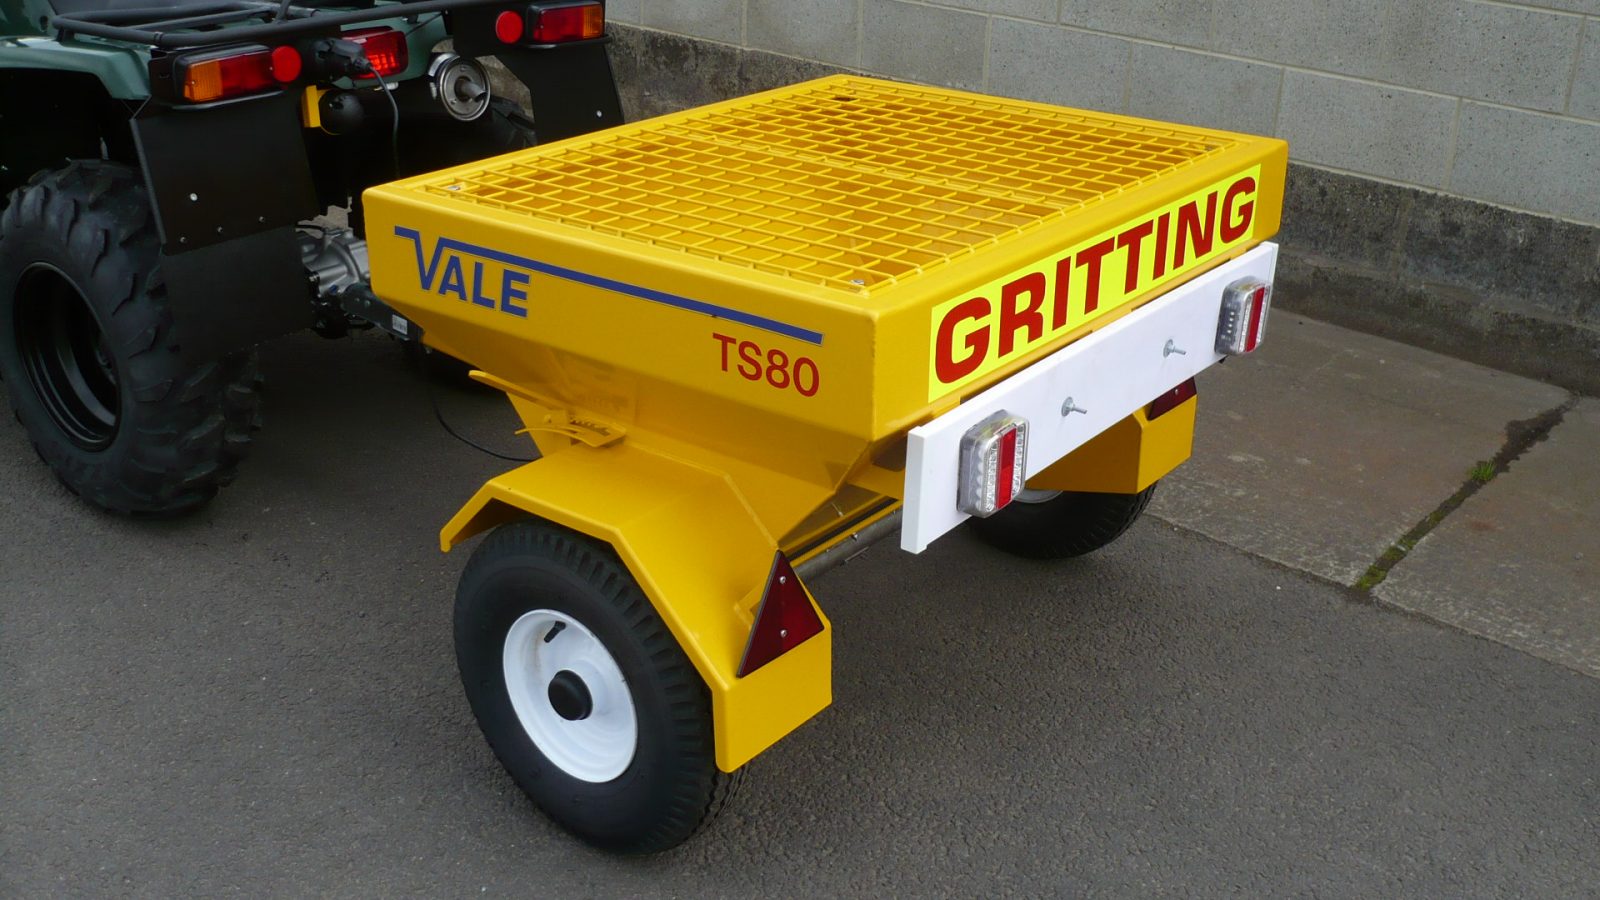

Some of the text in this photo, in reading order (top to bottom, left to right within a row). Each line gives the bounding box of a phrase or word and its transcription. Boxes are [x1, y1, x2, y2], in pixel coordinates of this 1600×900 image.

[395, 226, 529, 318] VALE
[935, 176, 1256, 383] GRITTING
[712, 332, 820, 397] TS80
